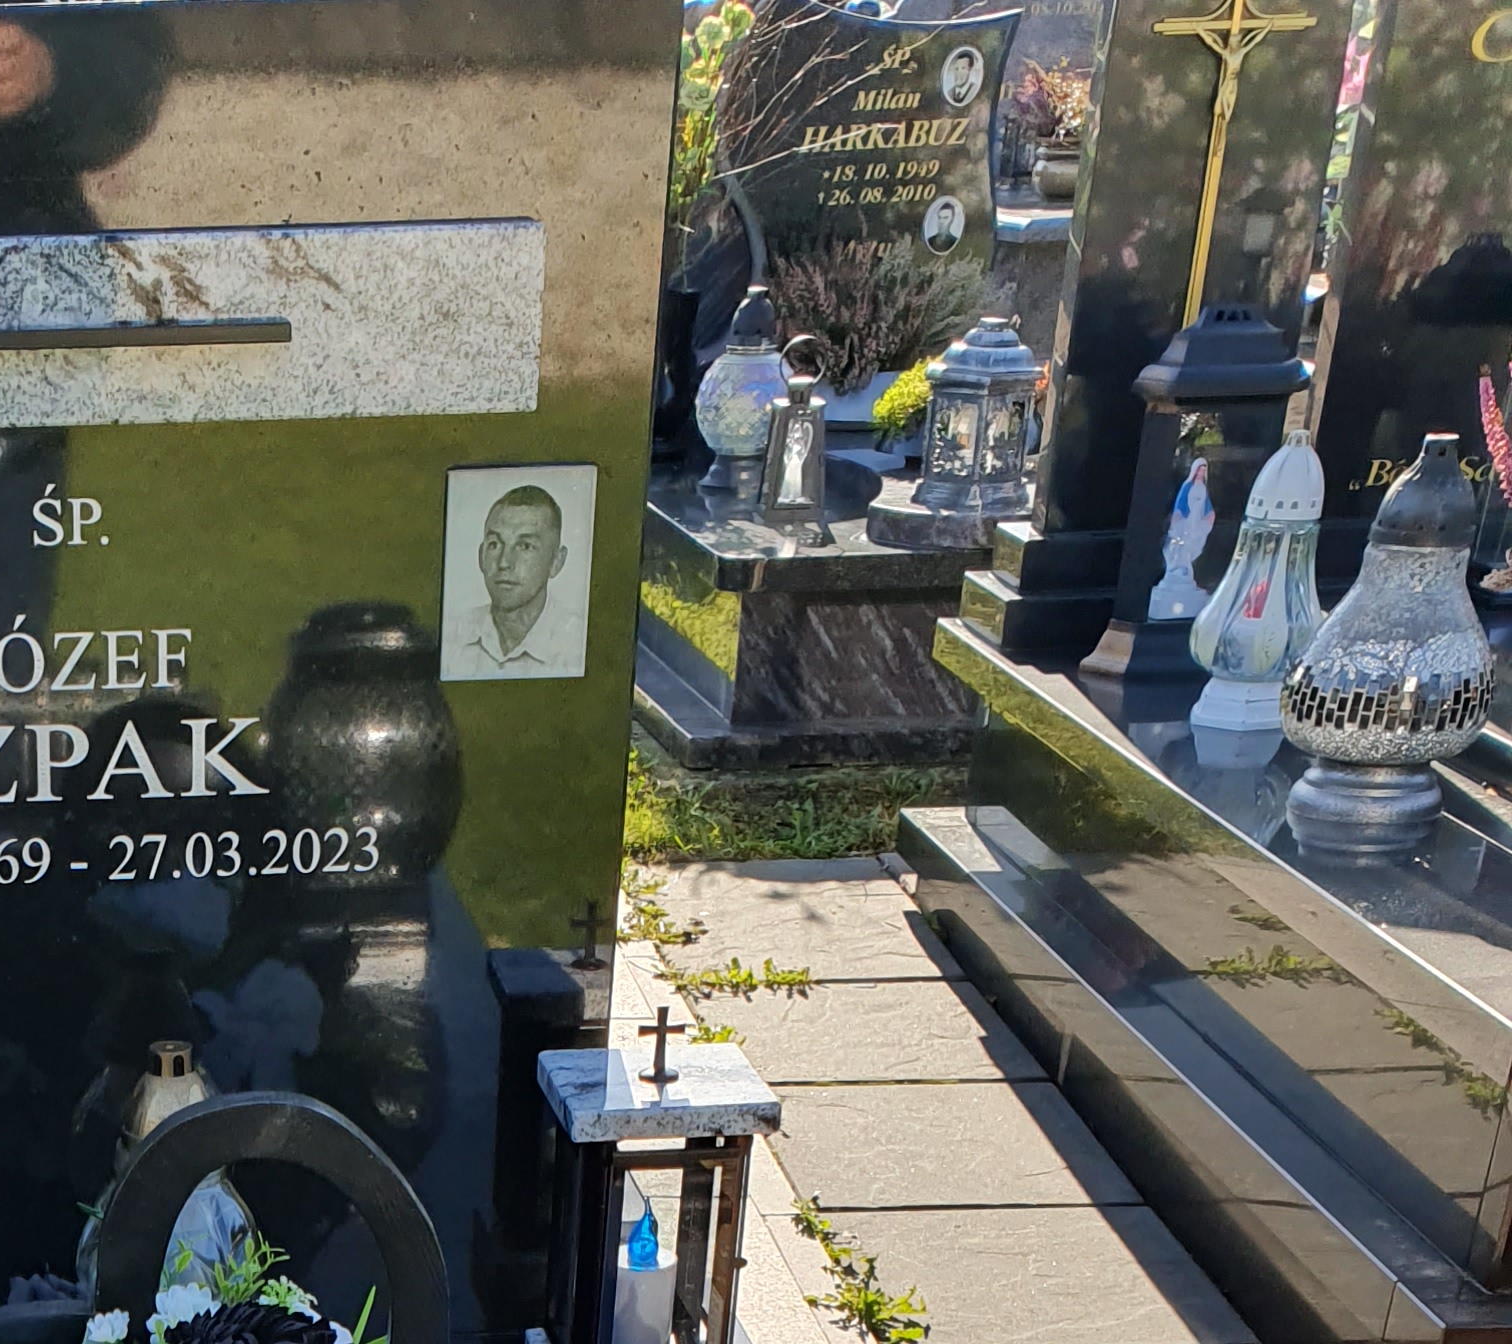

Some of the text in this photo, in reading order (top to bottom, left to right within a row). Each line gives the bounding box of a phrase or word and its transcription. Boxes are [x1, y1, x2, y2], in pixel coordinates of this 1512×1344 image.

[851, 88, 922, 112] Milan
[799, 117, 970, 153] HARKABUZ
[890, 183, 936, 202] 2010
[31, 483, 111, 547] ŚP.
[108, 825, 380, 882] 27.03.2023
